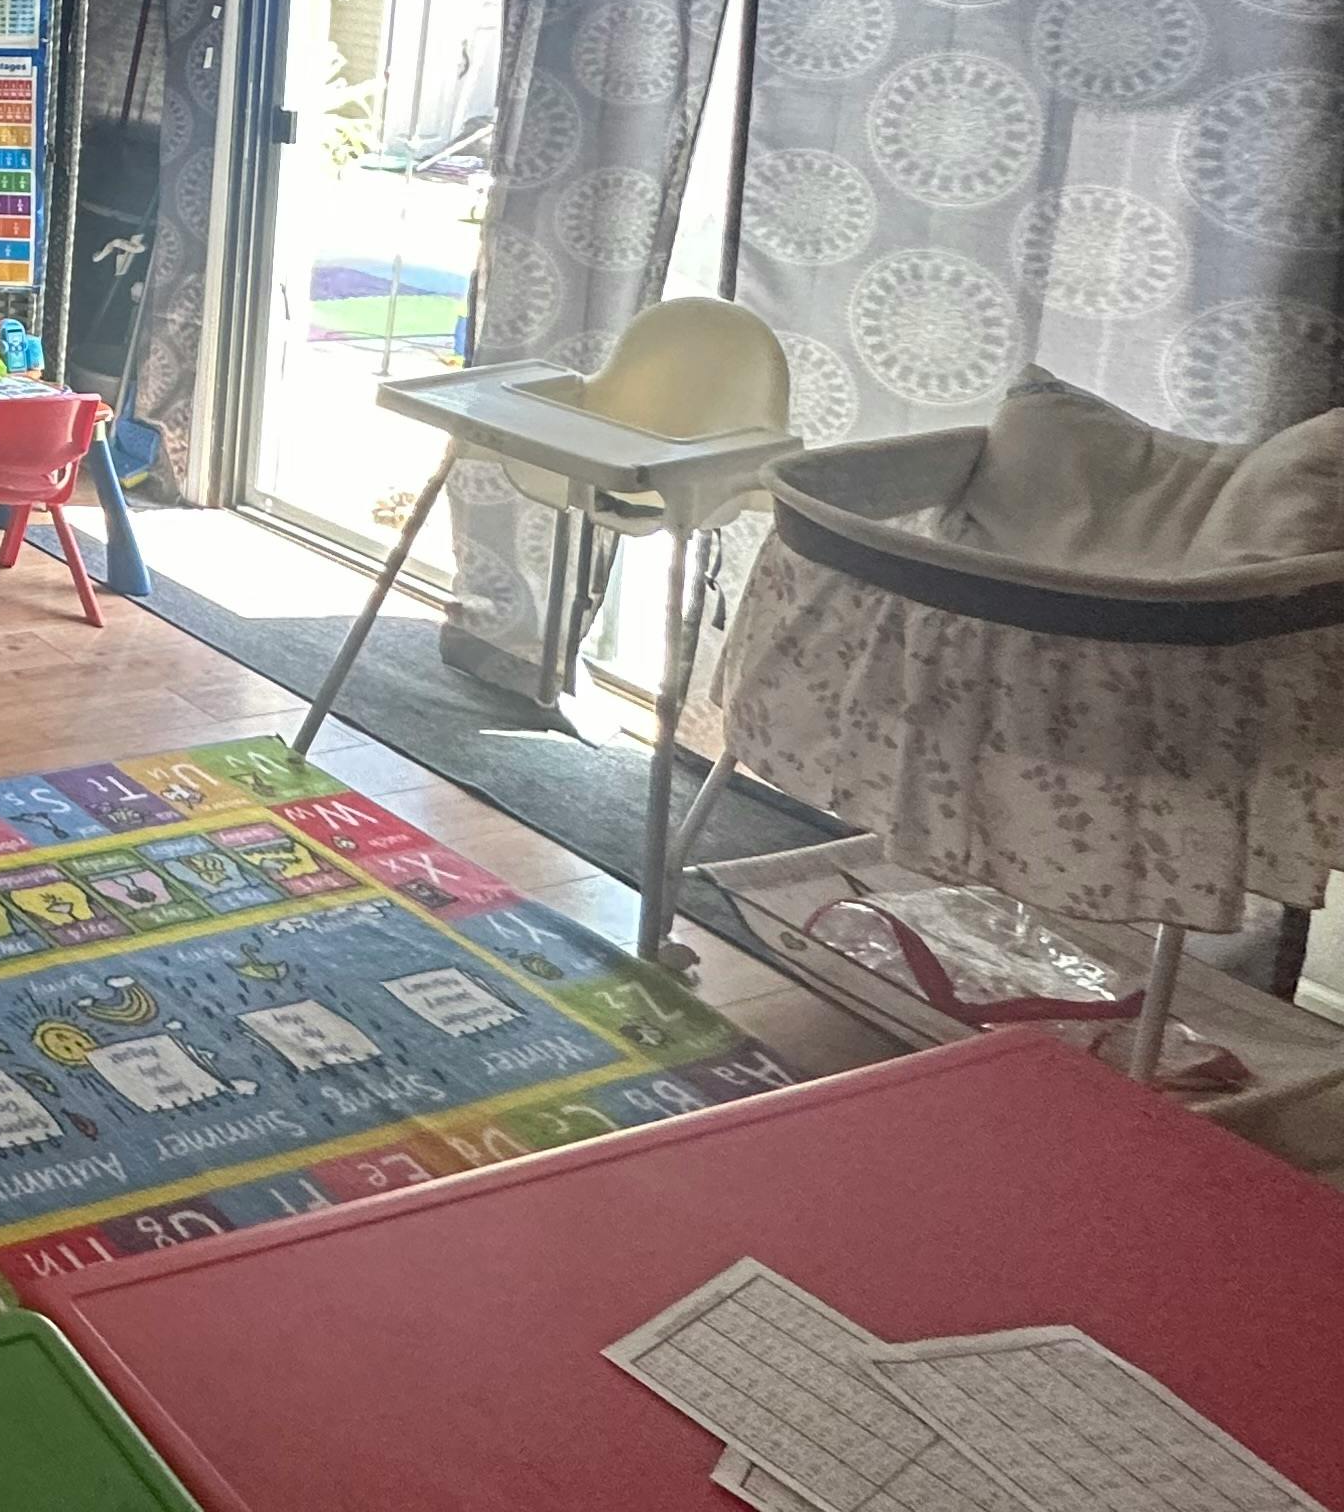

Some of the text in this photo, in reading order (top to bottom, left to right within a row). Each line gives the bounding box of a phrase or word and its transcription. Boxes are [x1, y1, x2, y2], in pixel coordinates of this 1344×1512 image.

[28, 974, 100, 995] Sunny
[479, 1033, 595, 1075] Winter
[320, 1075, 447, 1116] Spring
[157, 1110, 308, 1160] Summer
